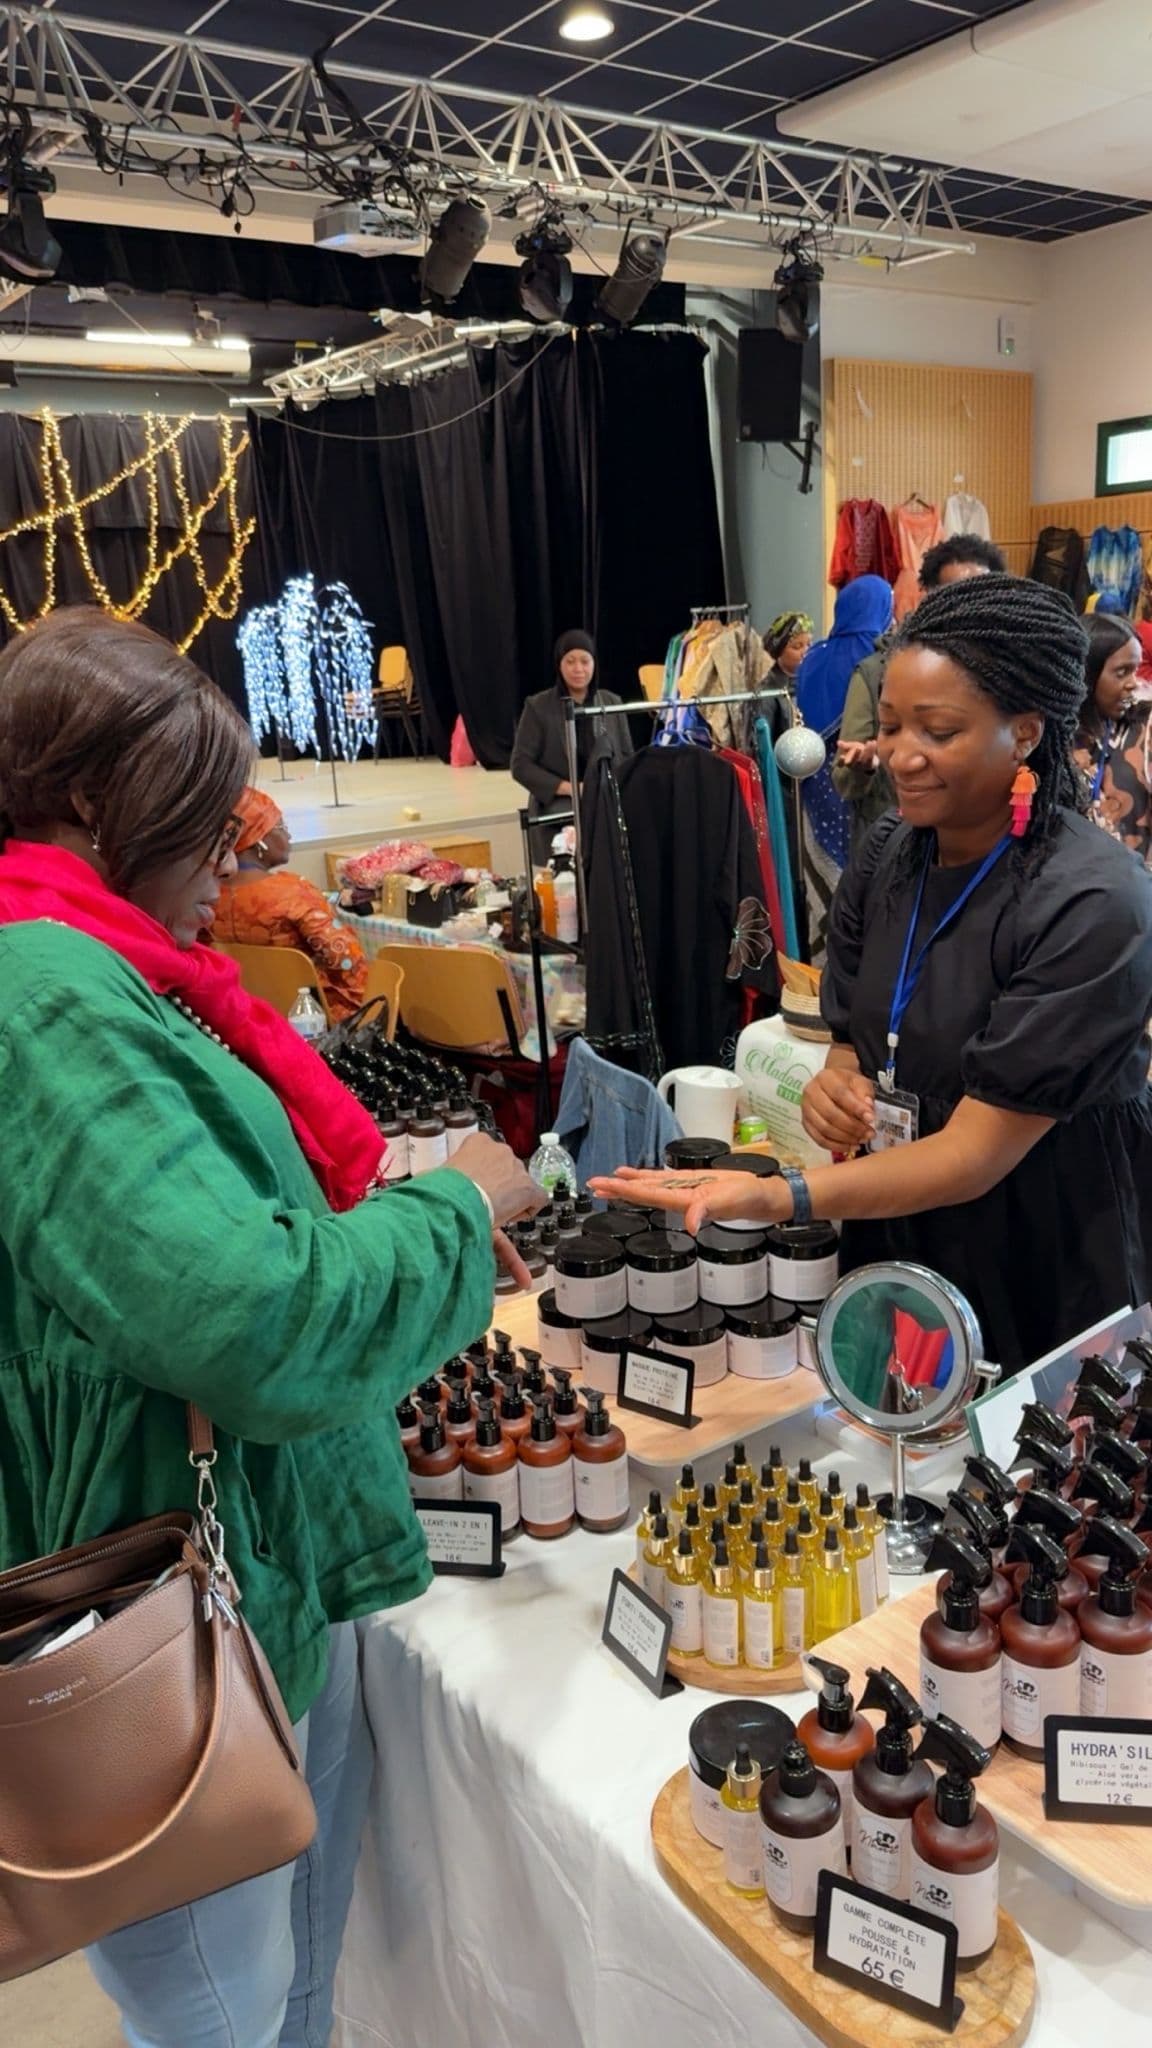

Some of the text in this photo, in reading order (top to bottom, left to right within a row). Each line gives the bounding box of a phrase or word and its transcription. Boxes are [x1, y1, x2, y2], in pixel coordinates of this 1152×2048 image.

[422, 1519, 458, 1528] LEAVE-IN
[1120, 1762, 1134, 1771] Gel
[1138, 1763, 1148, 1772] de
[843, 1902, 873, 1923] GAMME
[861, 1926, 911, 1956] POUSSE &
[848, 1933, 917, 1971] HYDRATATION
